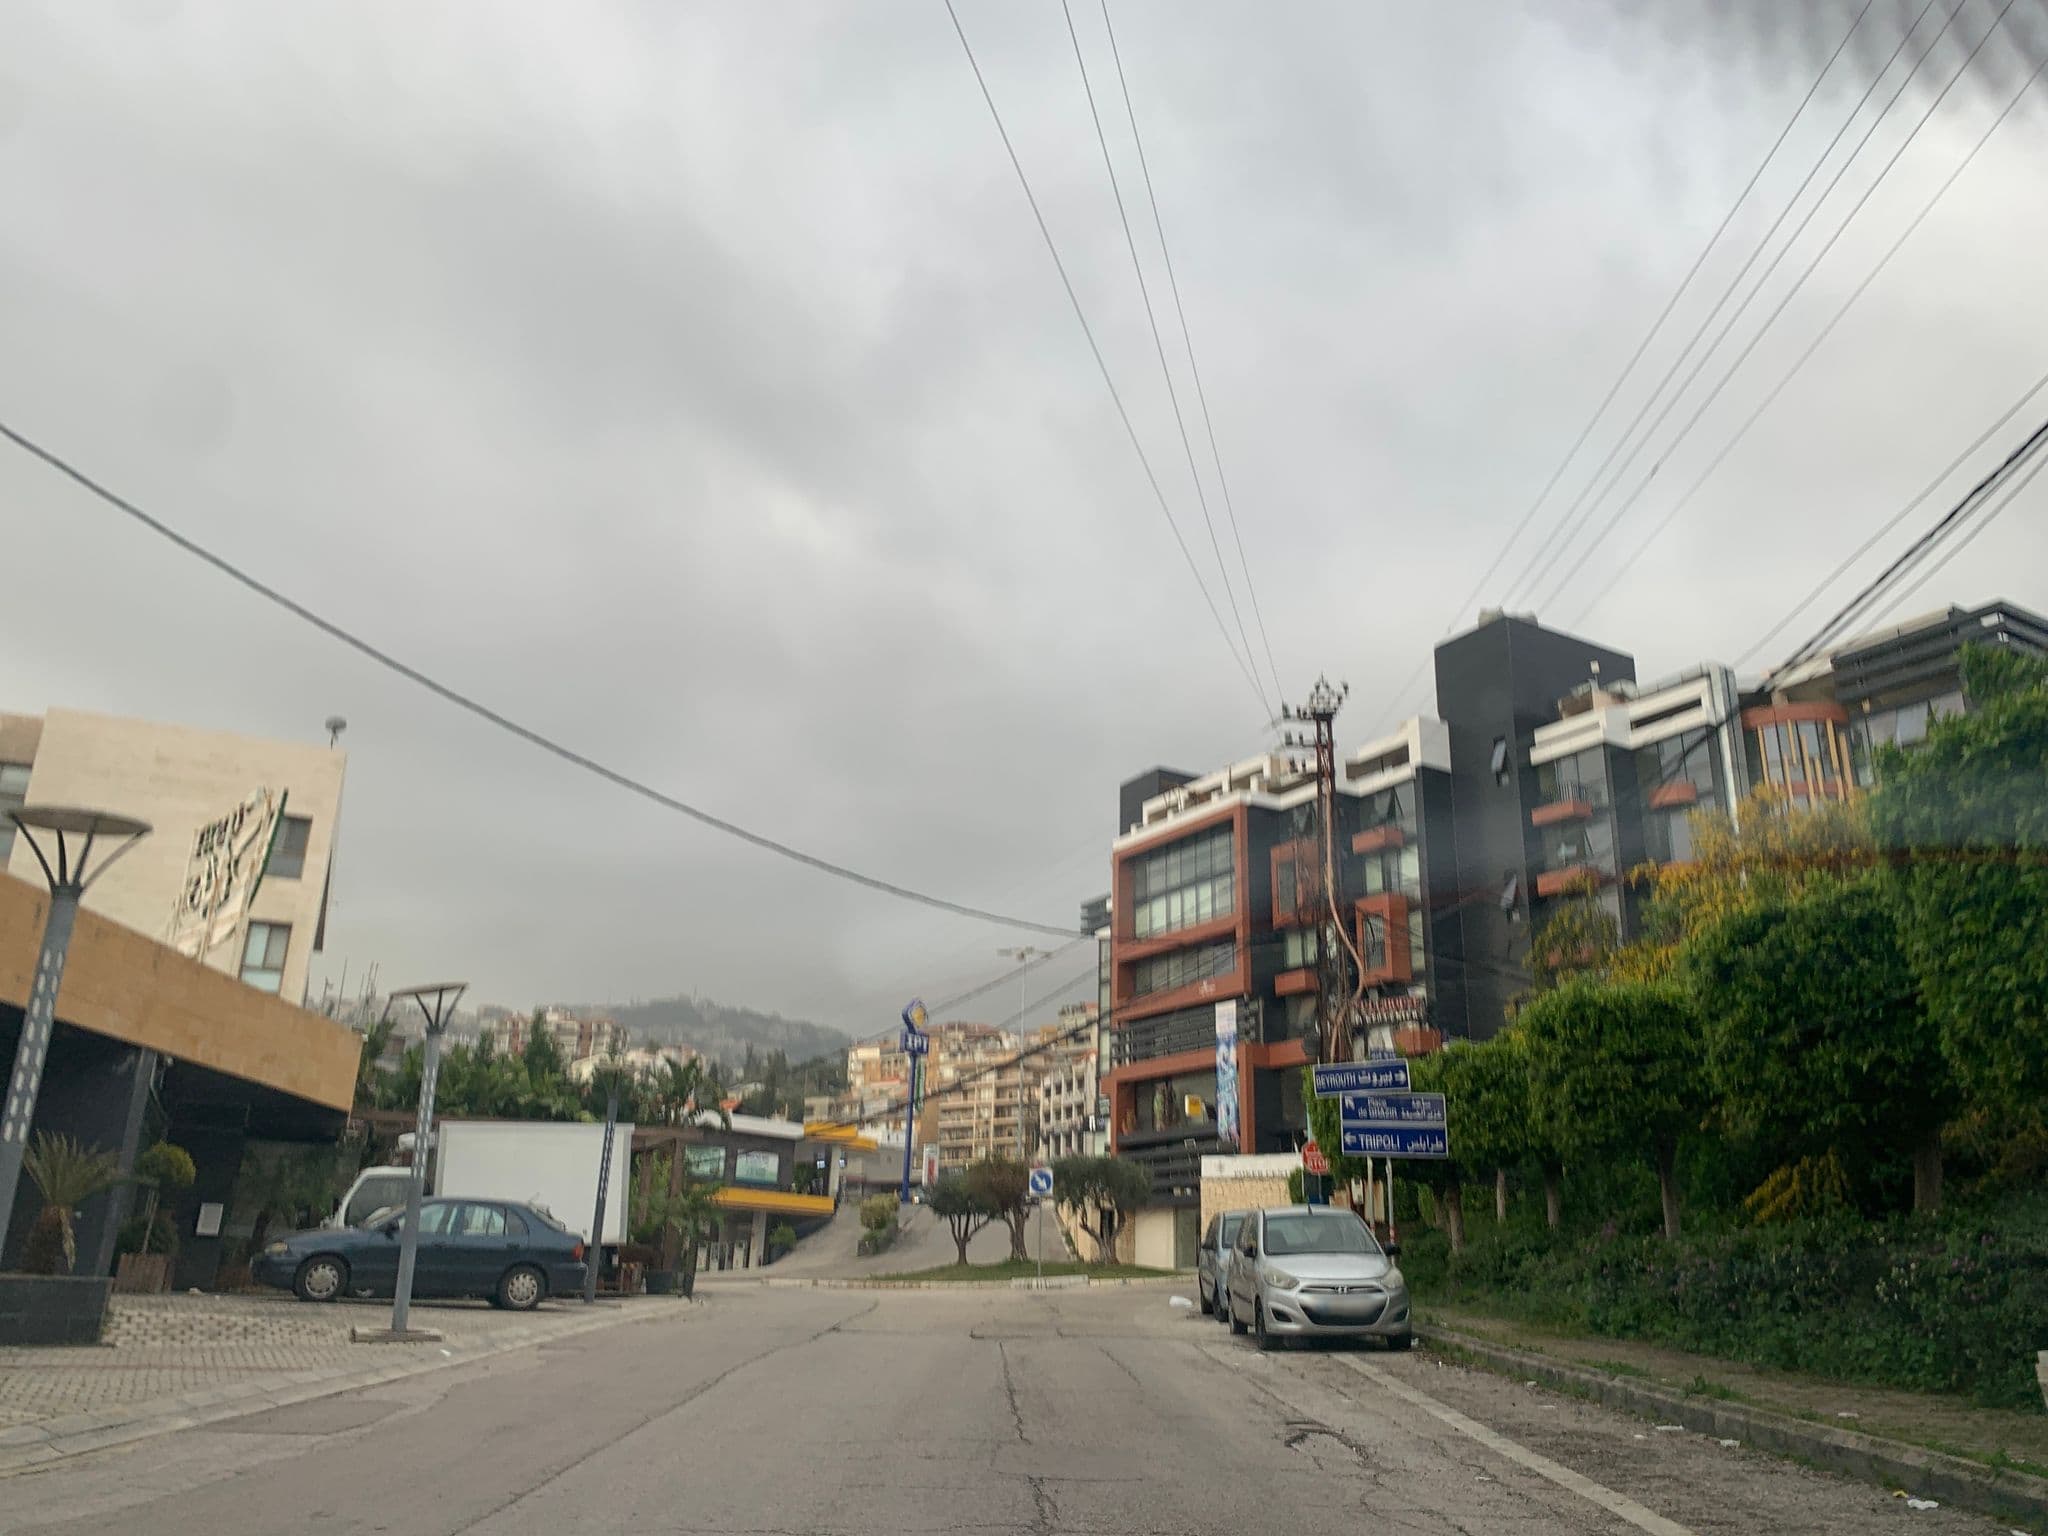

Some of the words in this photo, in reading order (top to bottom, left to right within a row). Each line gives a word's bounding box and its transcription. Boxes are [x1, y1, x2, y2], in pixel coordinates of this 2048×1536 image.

[1316, 1070, 1357, 1089] BEYROUTH
[1359, 1133, 1400, 1149] TRIPOLI
[1407, 1133, 1444, 1153] طرابلس
